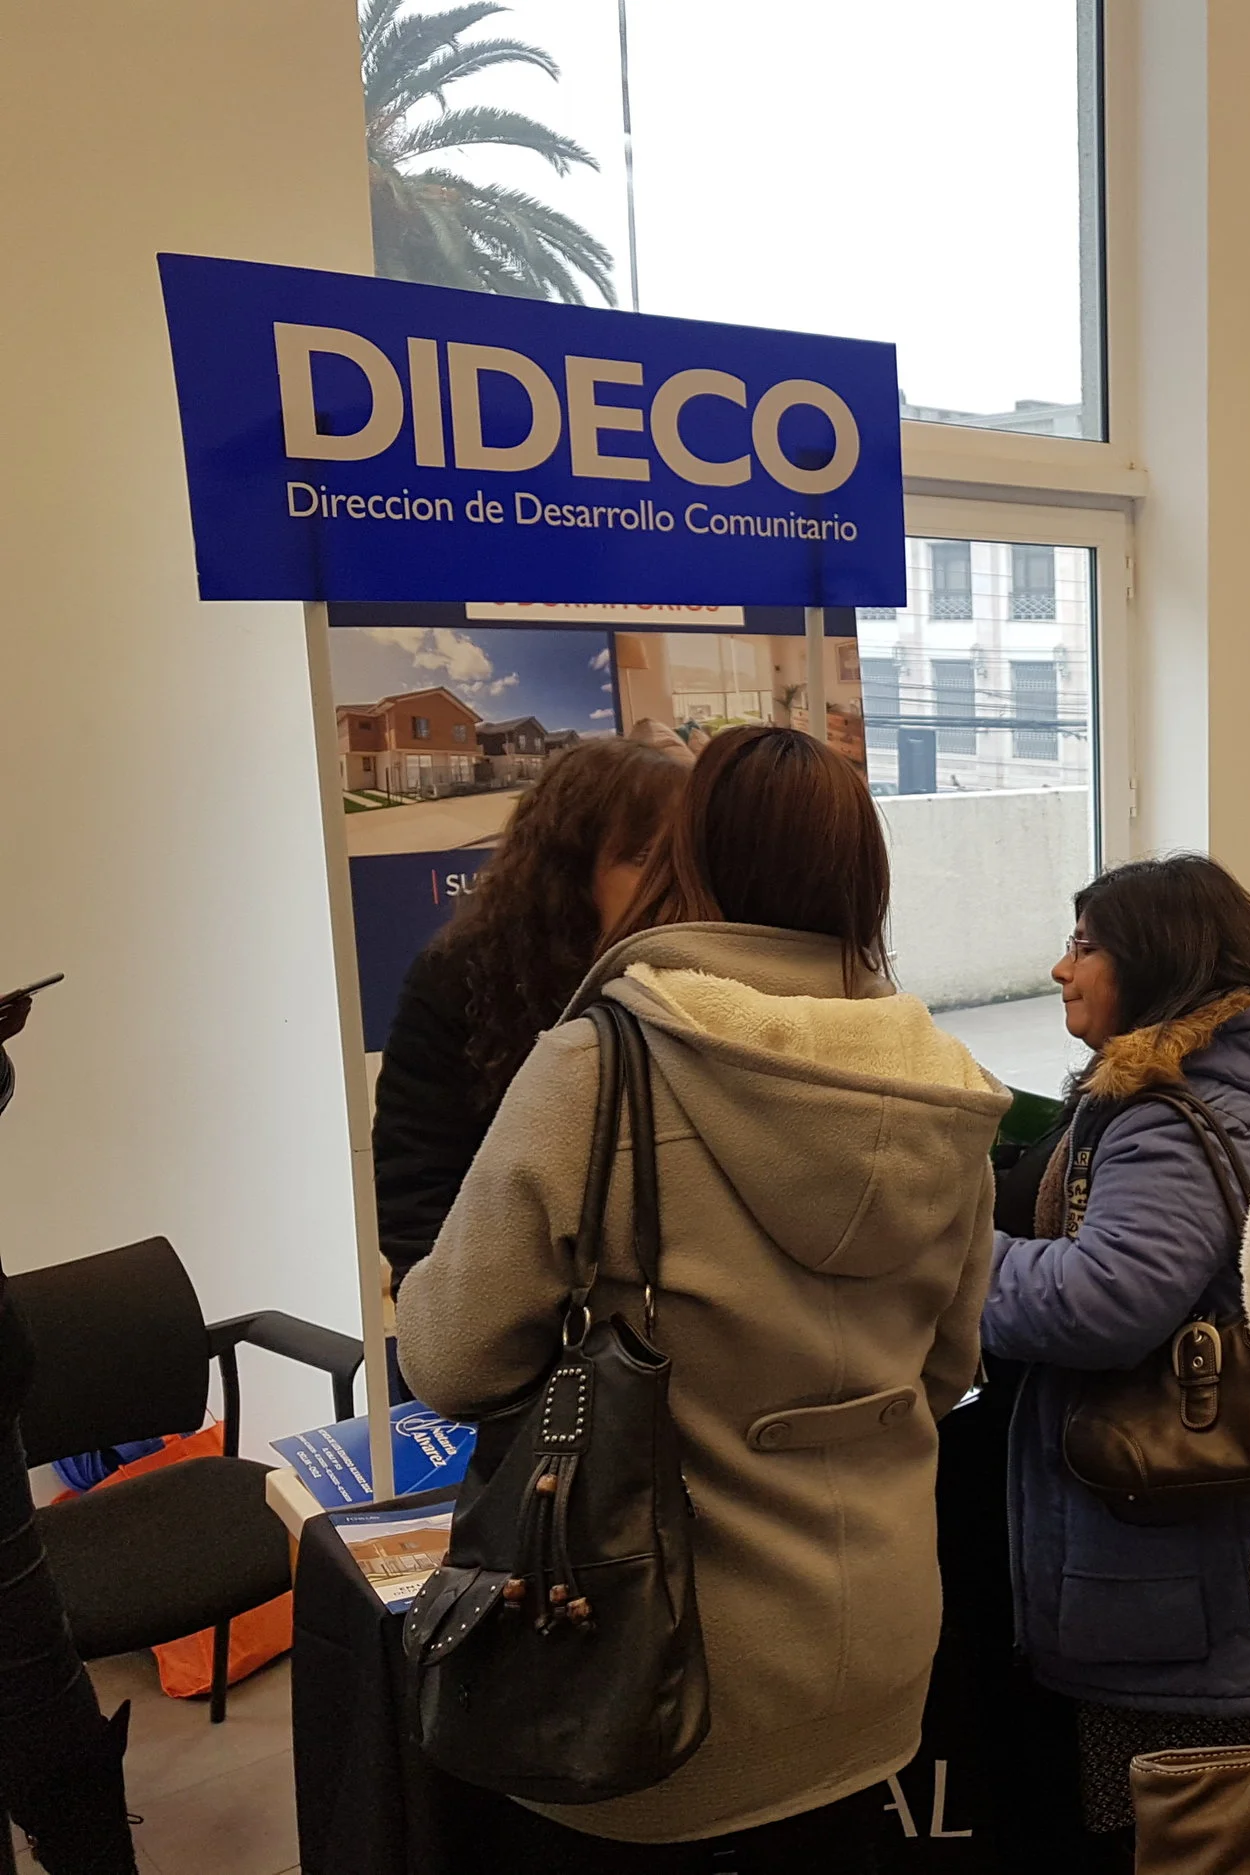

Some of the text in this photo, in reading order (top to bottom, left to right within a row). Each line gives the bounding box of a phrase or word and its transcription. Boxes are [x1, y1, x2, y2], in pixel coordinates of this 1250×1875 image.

[273, 321, 860, 494] DIDECO
[286, 481, 858, 542] Direccion de Desarrollo Comunitario
